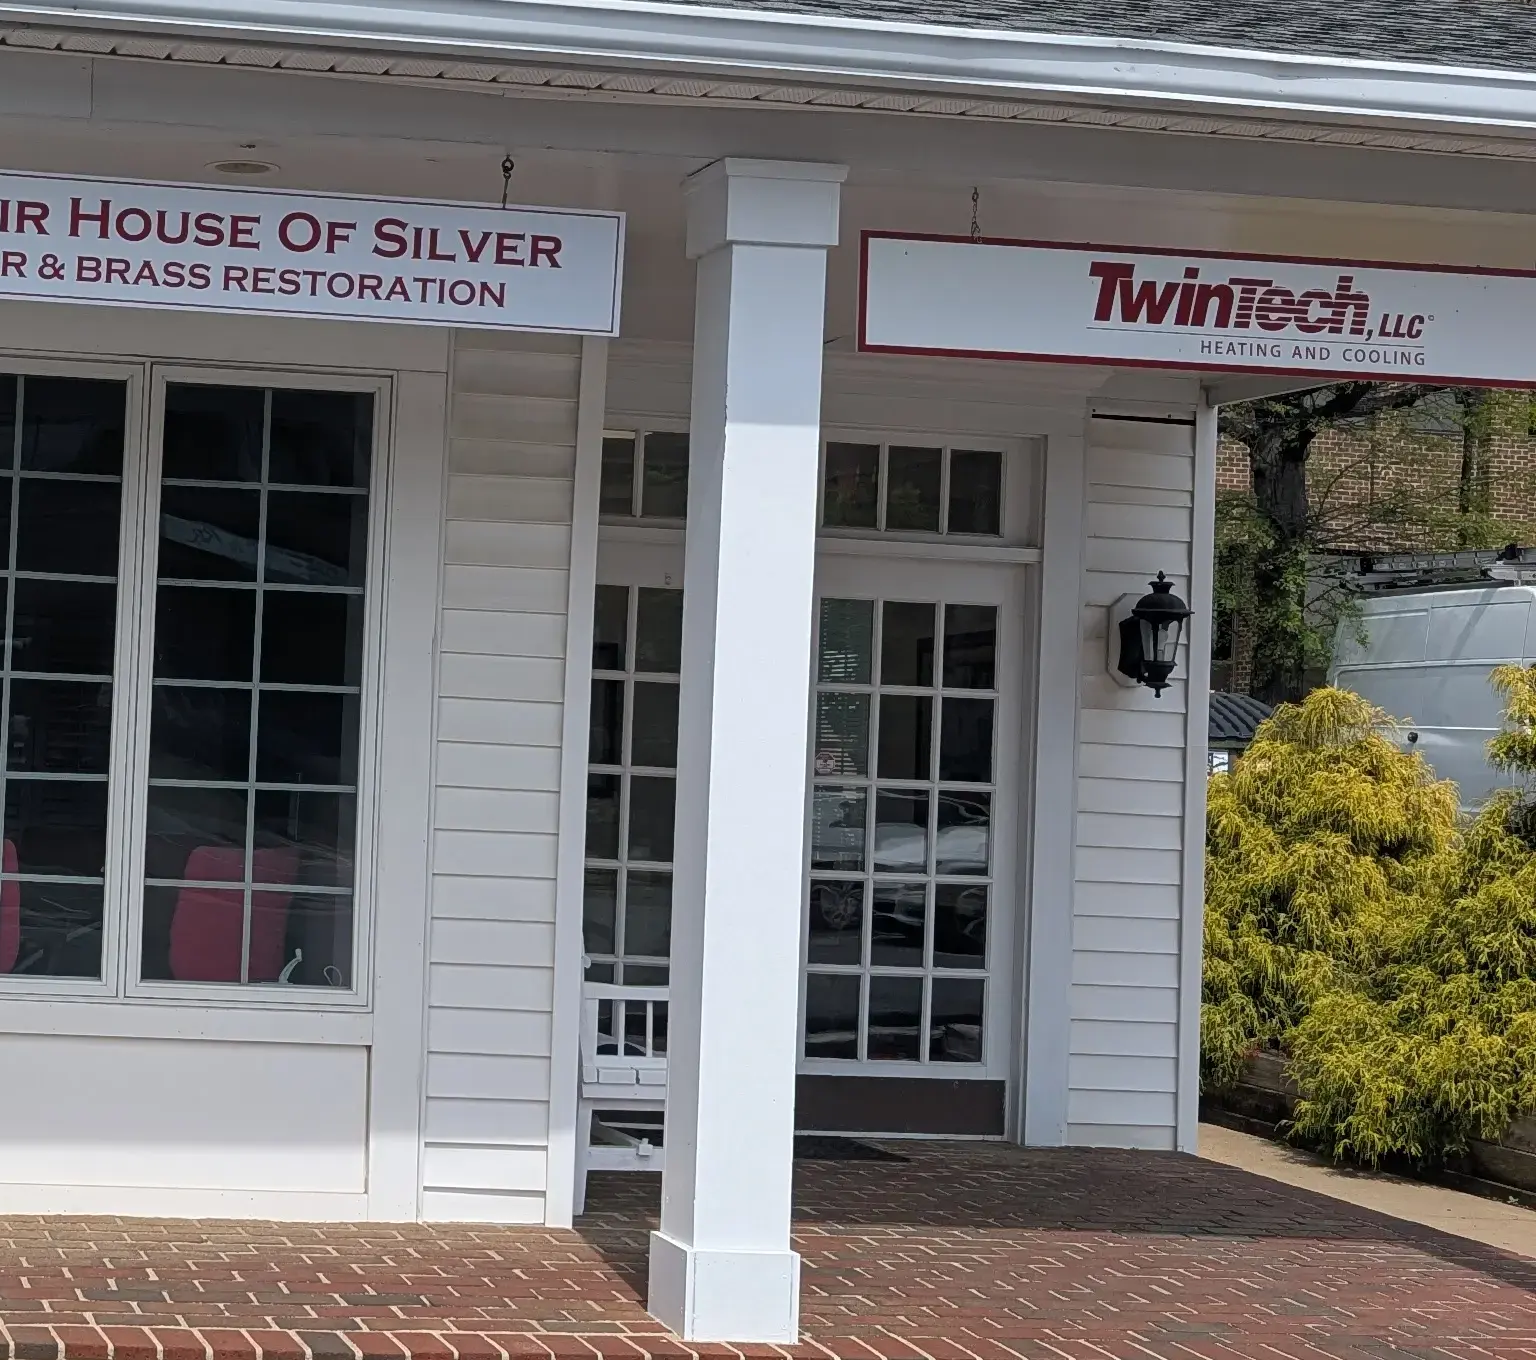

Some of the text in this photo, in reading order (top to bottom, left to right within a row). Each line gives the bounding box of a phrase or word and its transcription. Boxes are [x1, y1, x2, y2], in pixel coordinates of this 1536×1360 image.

[69, 197, 261, 250] HOUSE
[277, 211, 356, 255] OF
[373, 217, 563, 268] SILVER
[37, 253, 65, 282] &
[75, 255, 211, 290] BRASS
[222, 265, 507, 309] RESTORATION
[1200, 339, 1425, 367] HEATING AND COOLING
